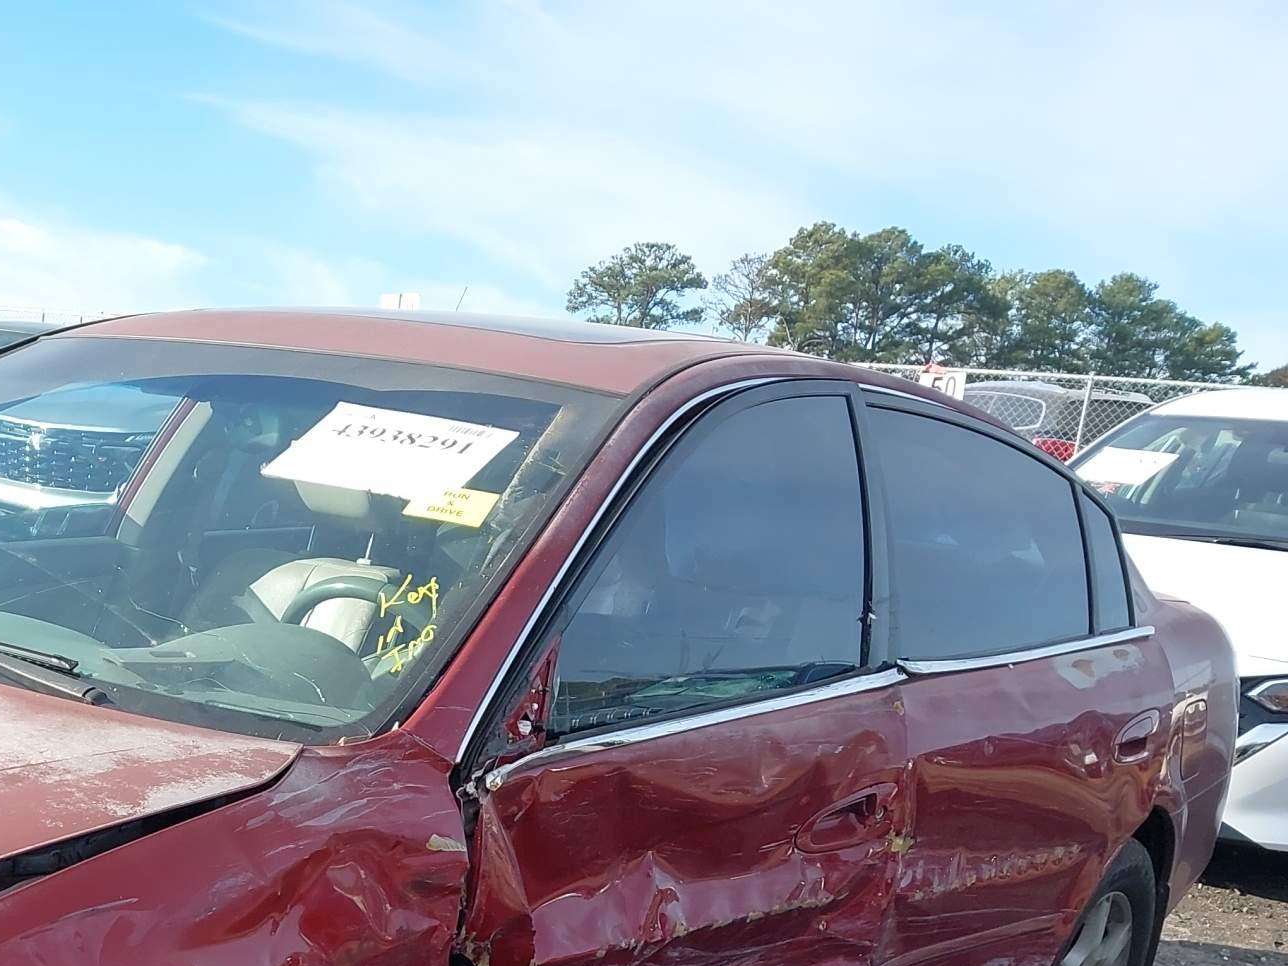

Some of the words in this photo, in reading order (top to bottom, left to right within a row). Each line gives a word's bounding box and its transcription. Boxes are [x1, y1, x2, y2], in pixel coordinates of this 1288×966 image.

[332, 423, 473, 454] 43938291
[442, 490, 471, 501] RUN
[426, 505, 465, 517] DRIVE
